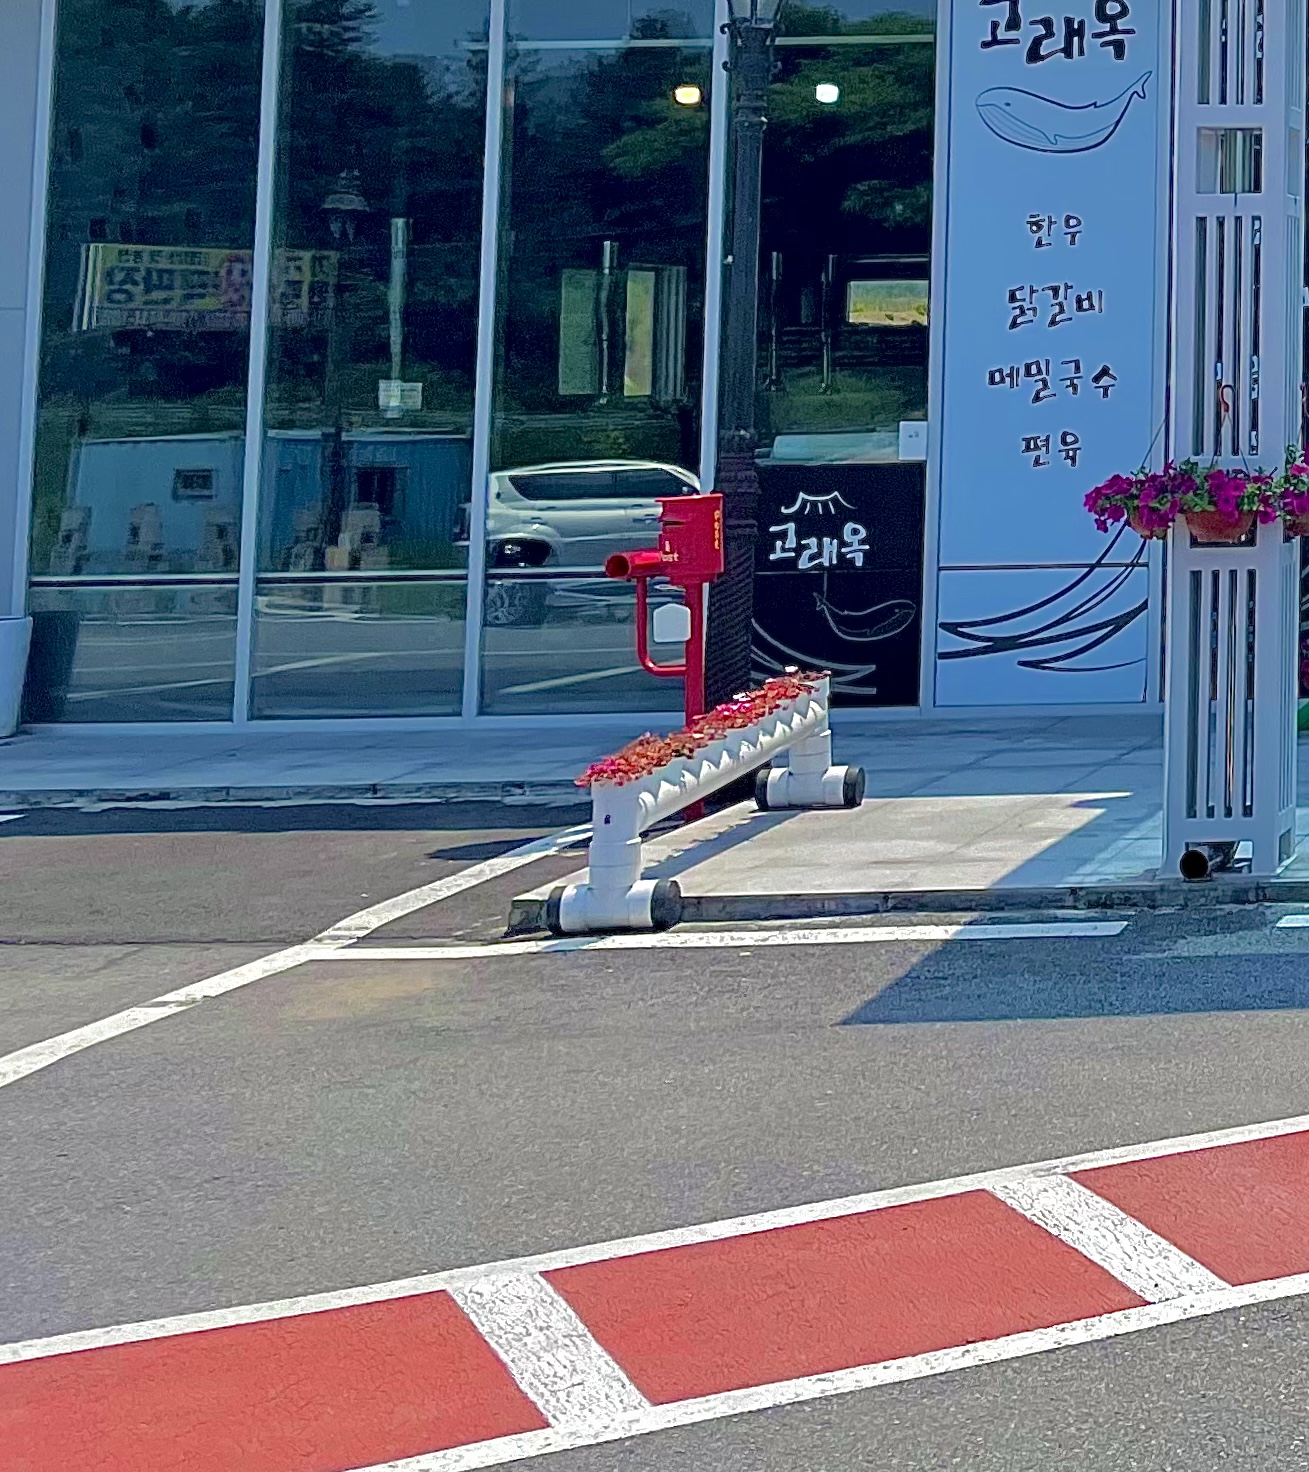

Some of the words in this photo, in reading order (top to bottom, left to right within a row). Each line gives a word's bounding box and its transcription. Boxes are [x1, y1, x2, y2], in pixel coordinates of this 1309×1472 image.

[1026, 213, 1083, 249] 한우
[1007, 282, 1103, 330] 닭갈비
[987, 358, 1118, 404] 메밀국수
[1021, 430, 1082, 468] 편육
[769, 521, 870, 569] 고래옥
